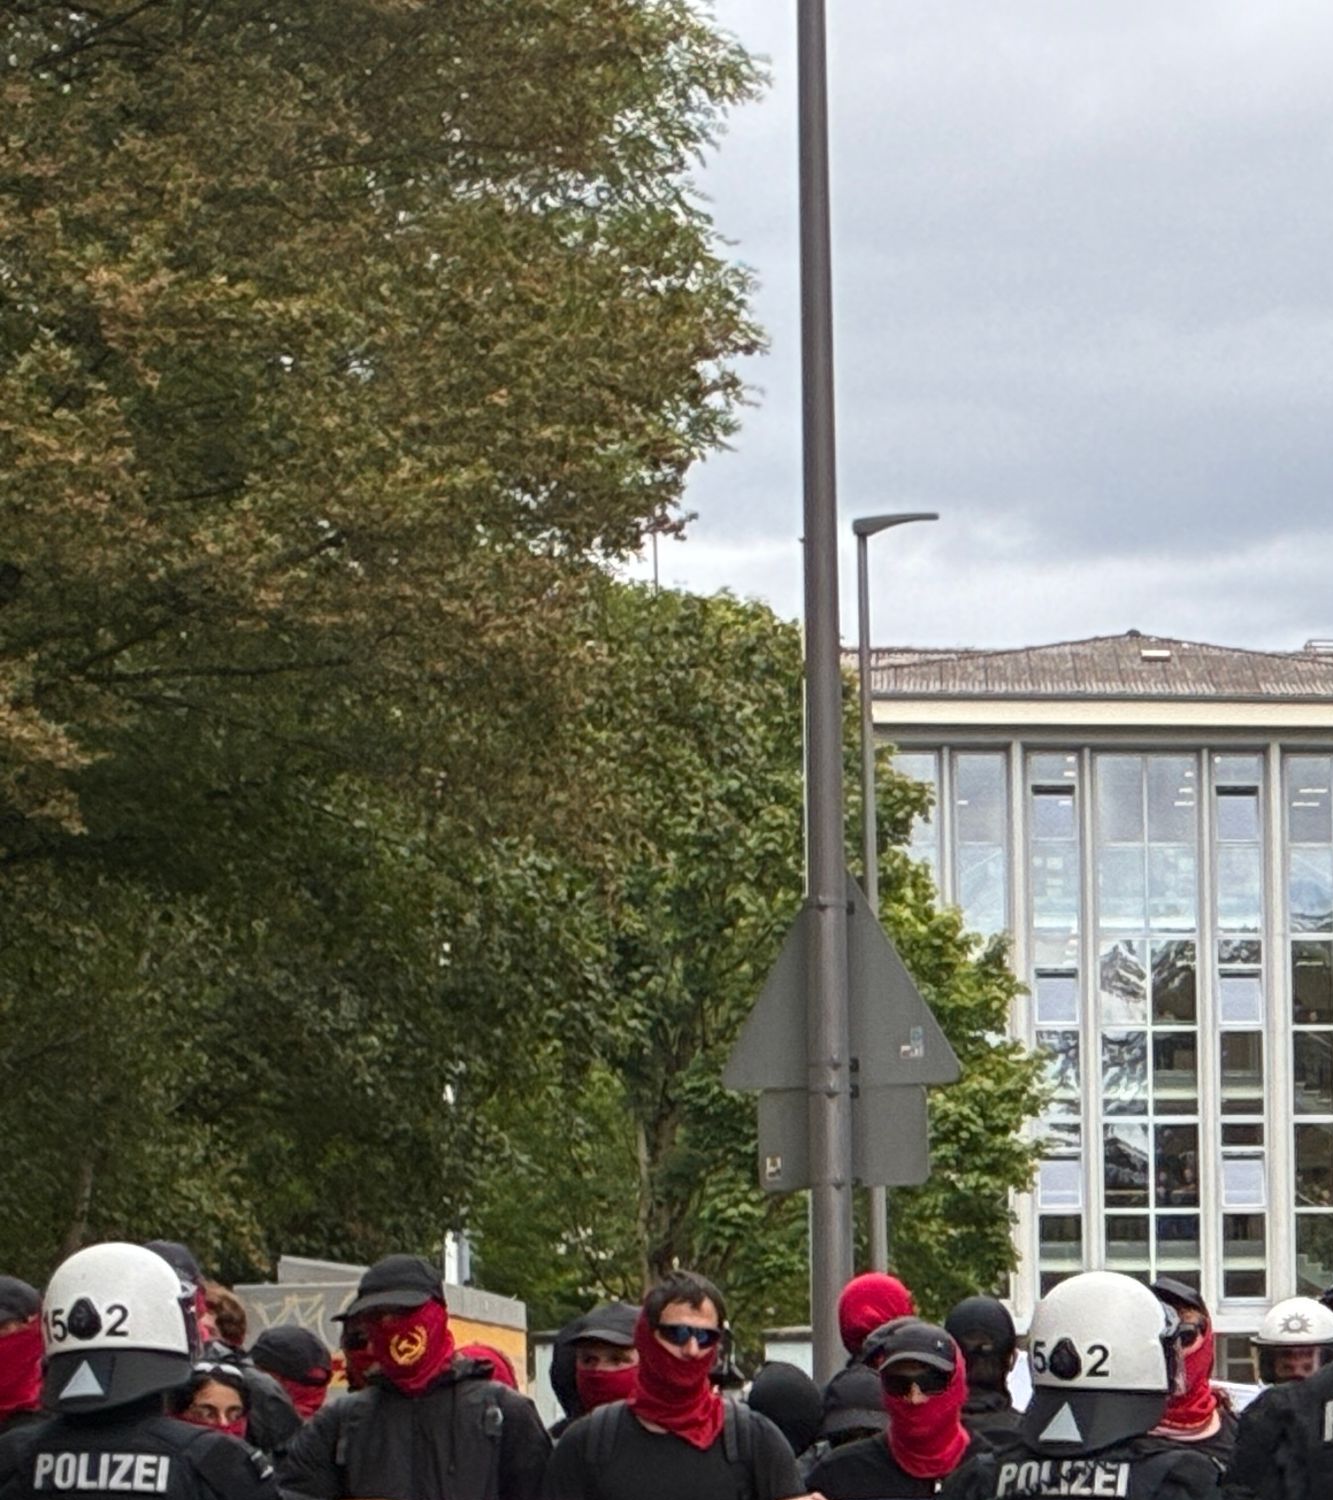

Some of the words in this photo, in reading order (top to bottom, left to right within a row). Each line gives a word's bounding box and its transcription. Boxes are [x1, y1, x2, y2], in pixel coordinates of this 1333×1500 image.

[105, 1304, 129, 1337] 2
[1086, 1344, 1110, 1377] 2
[34, 1453, 170, 1493] POLIZEI
[998, 1460, 1130, 1498] POLIZEI
